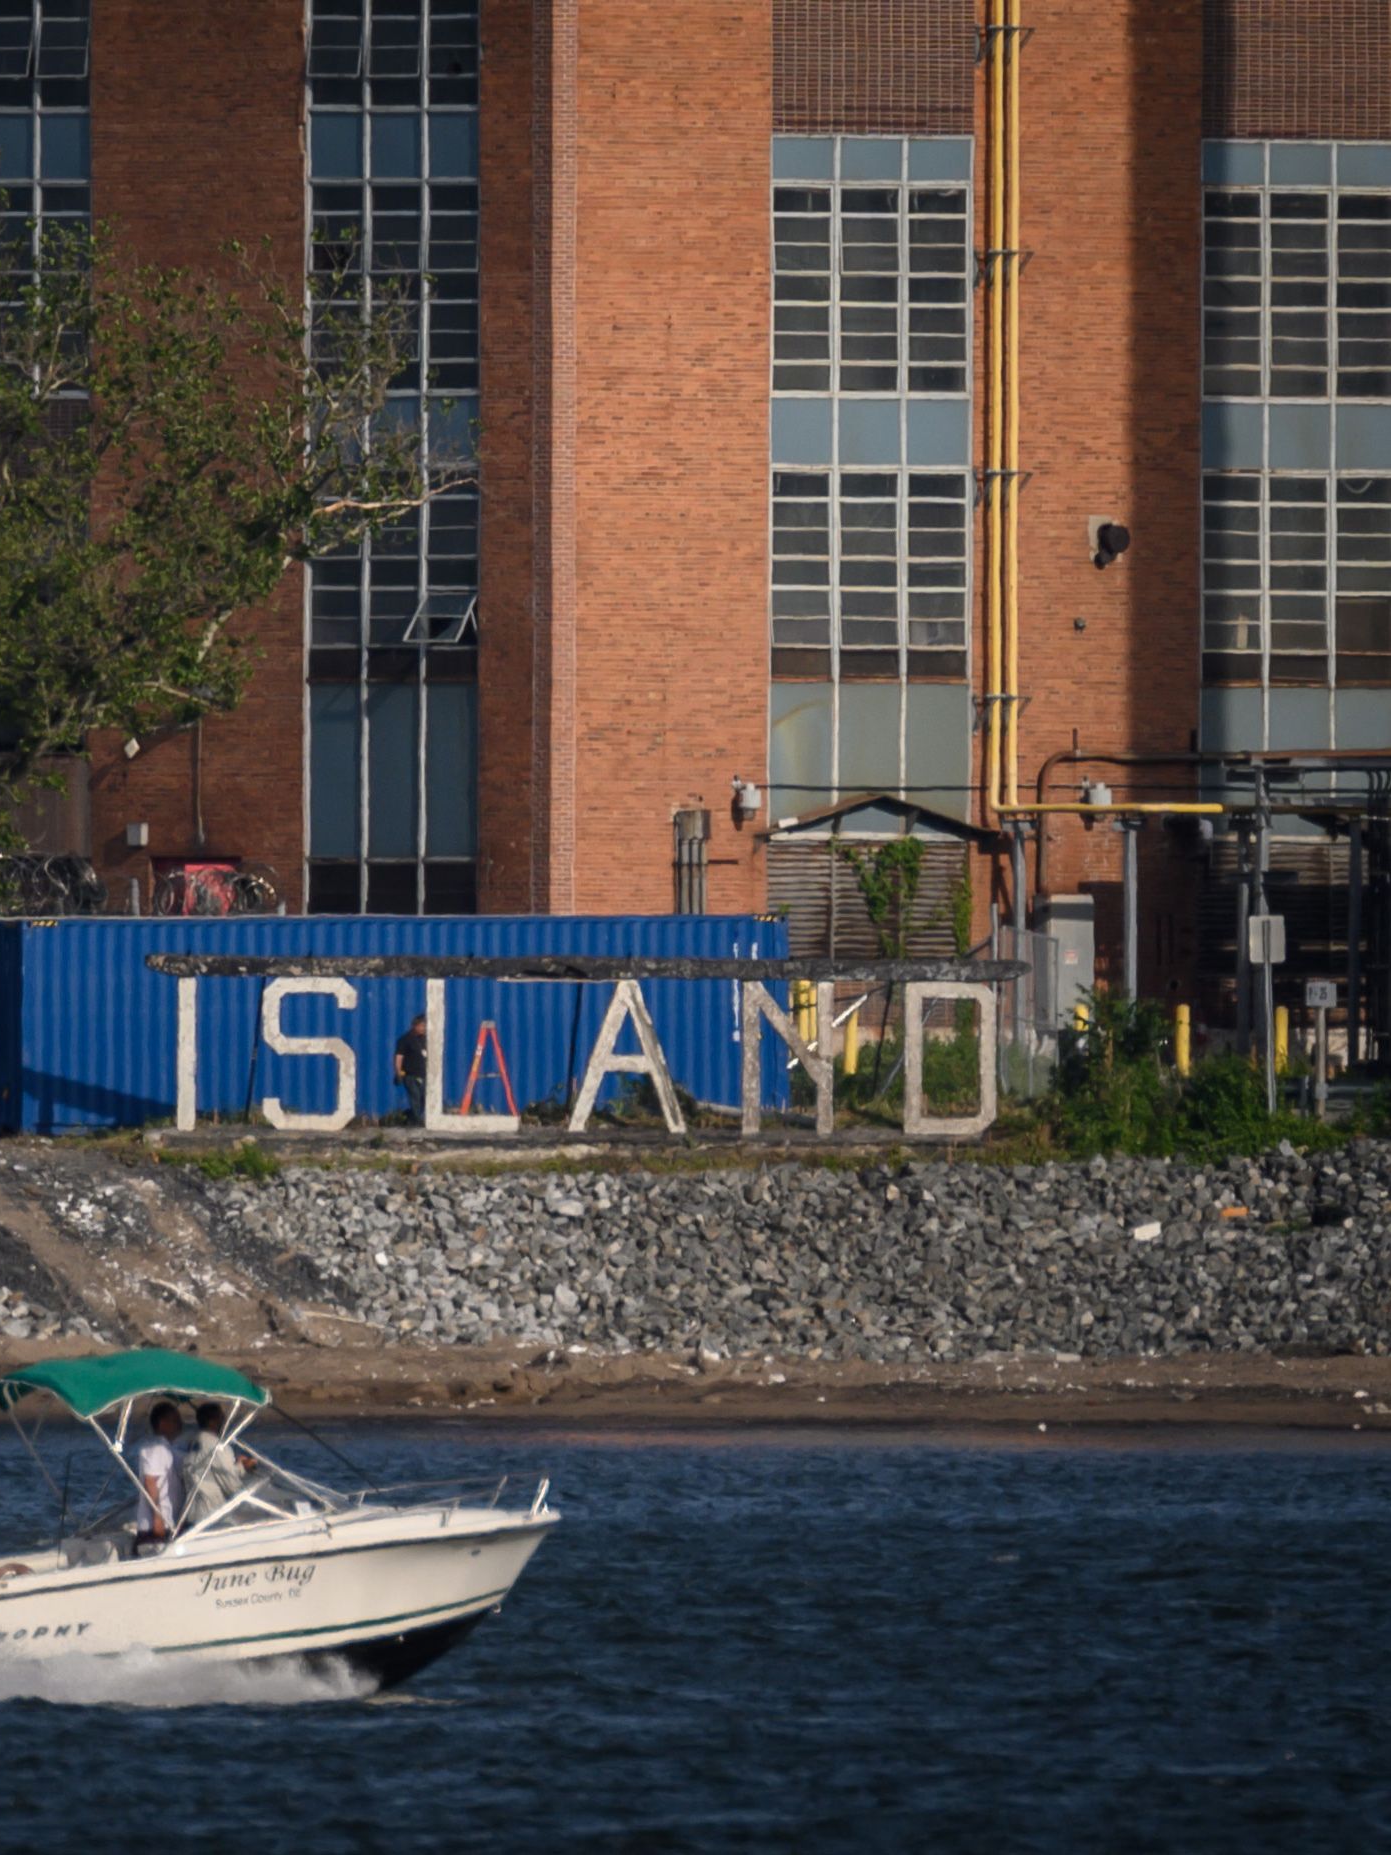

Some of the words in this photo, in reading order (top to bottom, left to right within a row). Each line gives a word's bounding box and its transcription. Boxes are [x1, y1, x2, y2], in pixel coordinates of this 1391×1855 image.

[176, 976, 998, 1136] ISLAND
[195, 1570, 257, 1597] June
[265, 1561, 316, 1586] Bug
[250, 1591, 283, 1604] County
